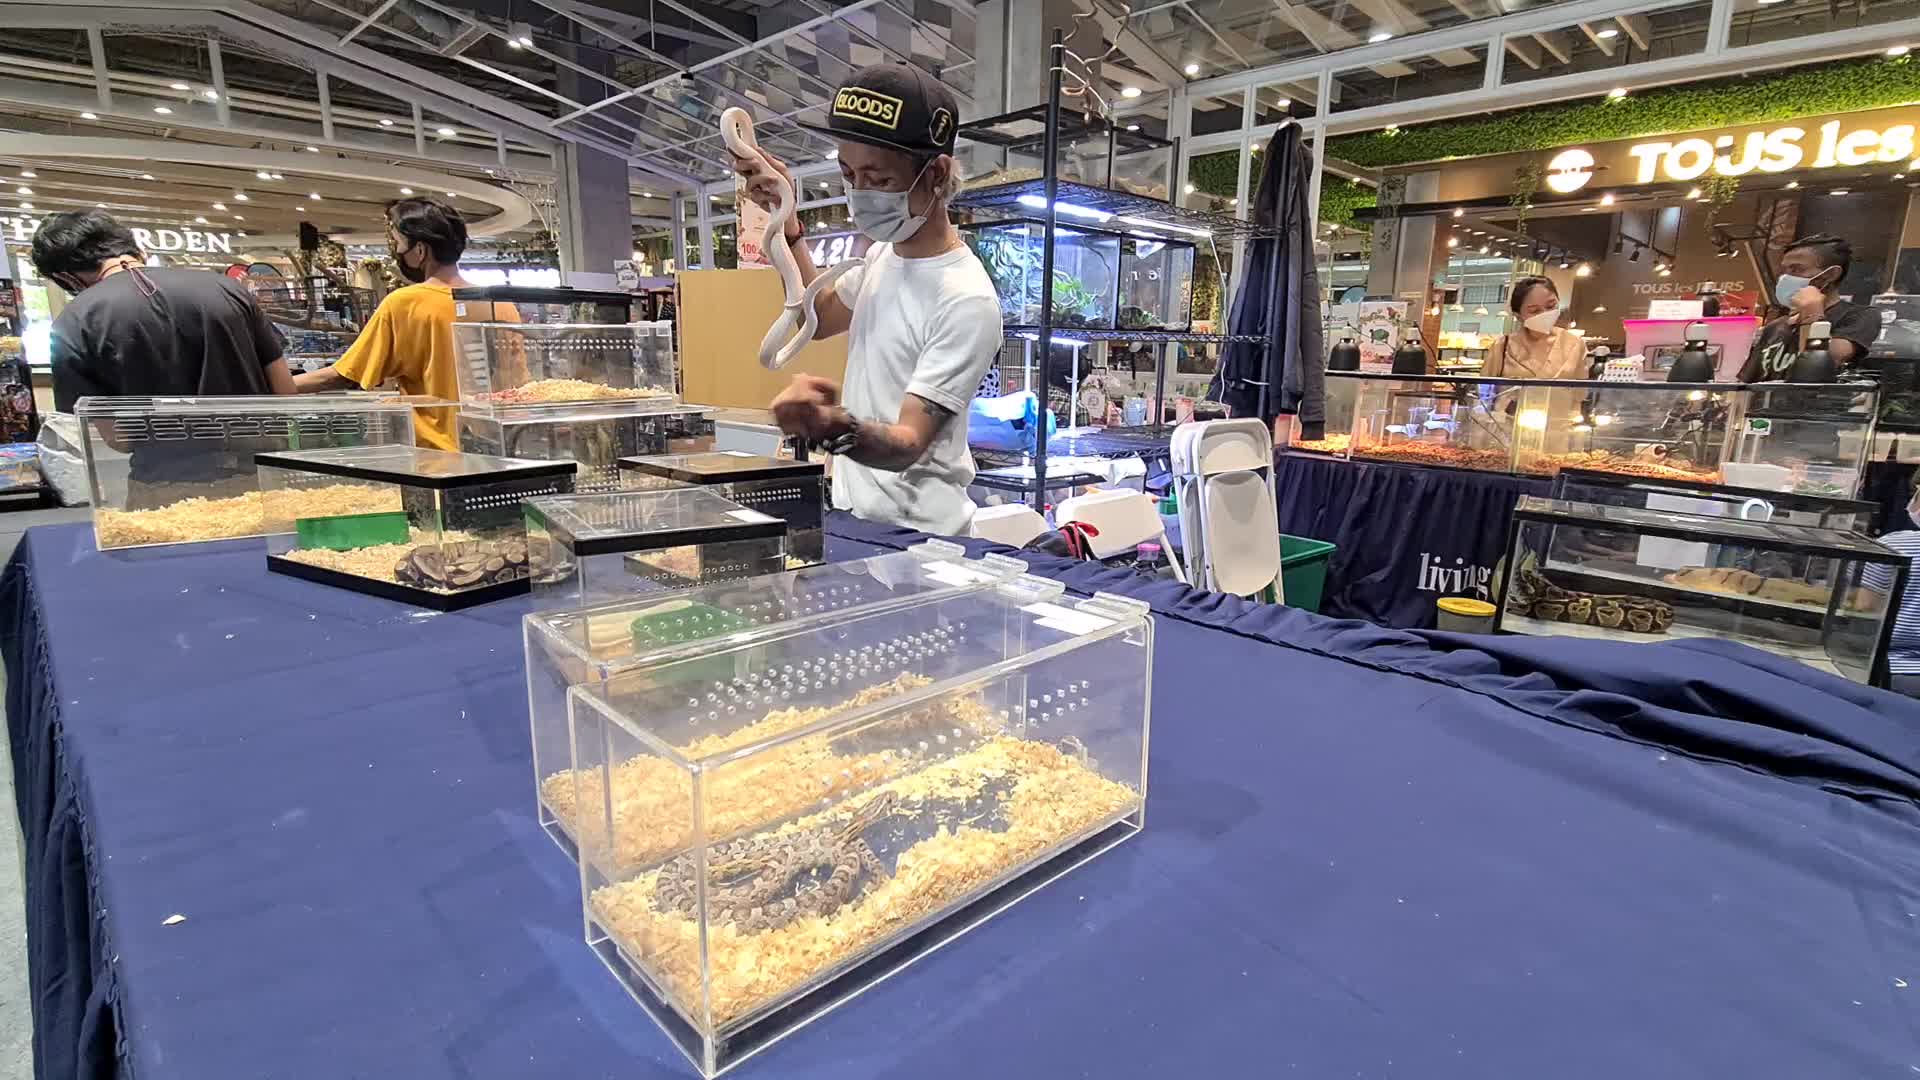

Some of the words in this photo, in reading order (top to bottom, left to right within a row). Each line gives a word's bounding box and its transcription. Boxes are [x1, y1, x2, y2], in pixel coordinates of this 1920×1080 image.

[836, 93, 895, 120] BLOODS
[1629, 127, 1806, 184] TOUS
[1810, 119, 1916, 168] les
[130, 227, 232, 254] RDEN
[1632, 283, 1673, 295] TOUS
[1695, 281, 1745, 297] JURS
[1416, 552, 1491, 600] living
